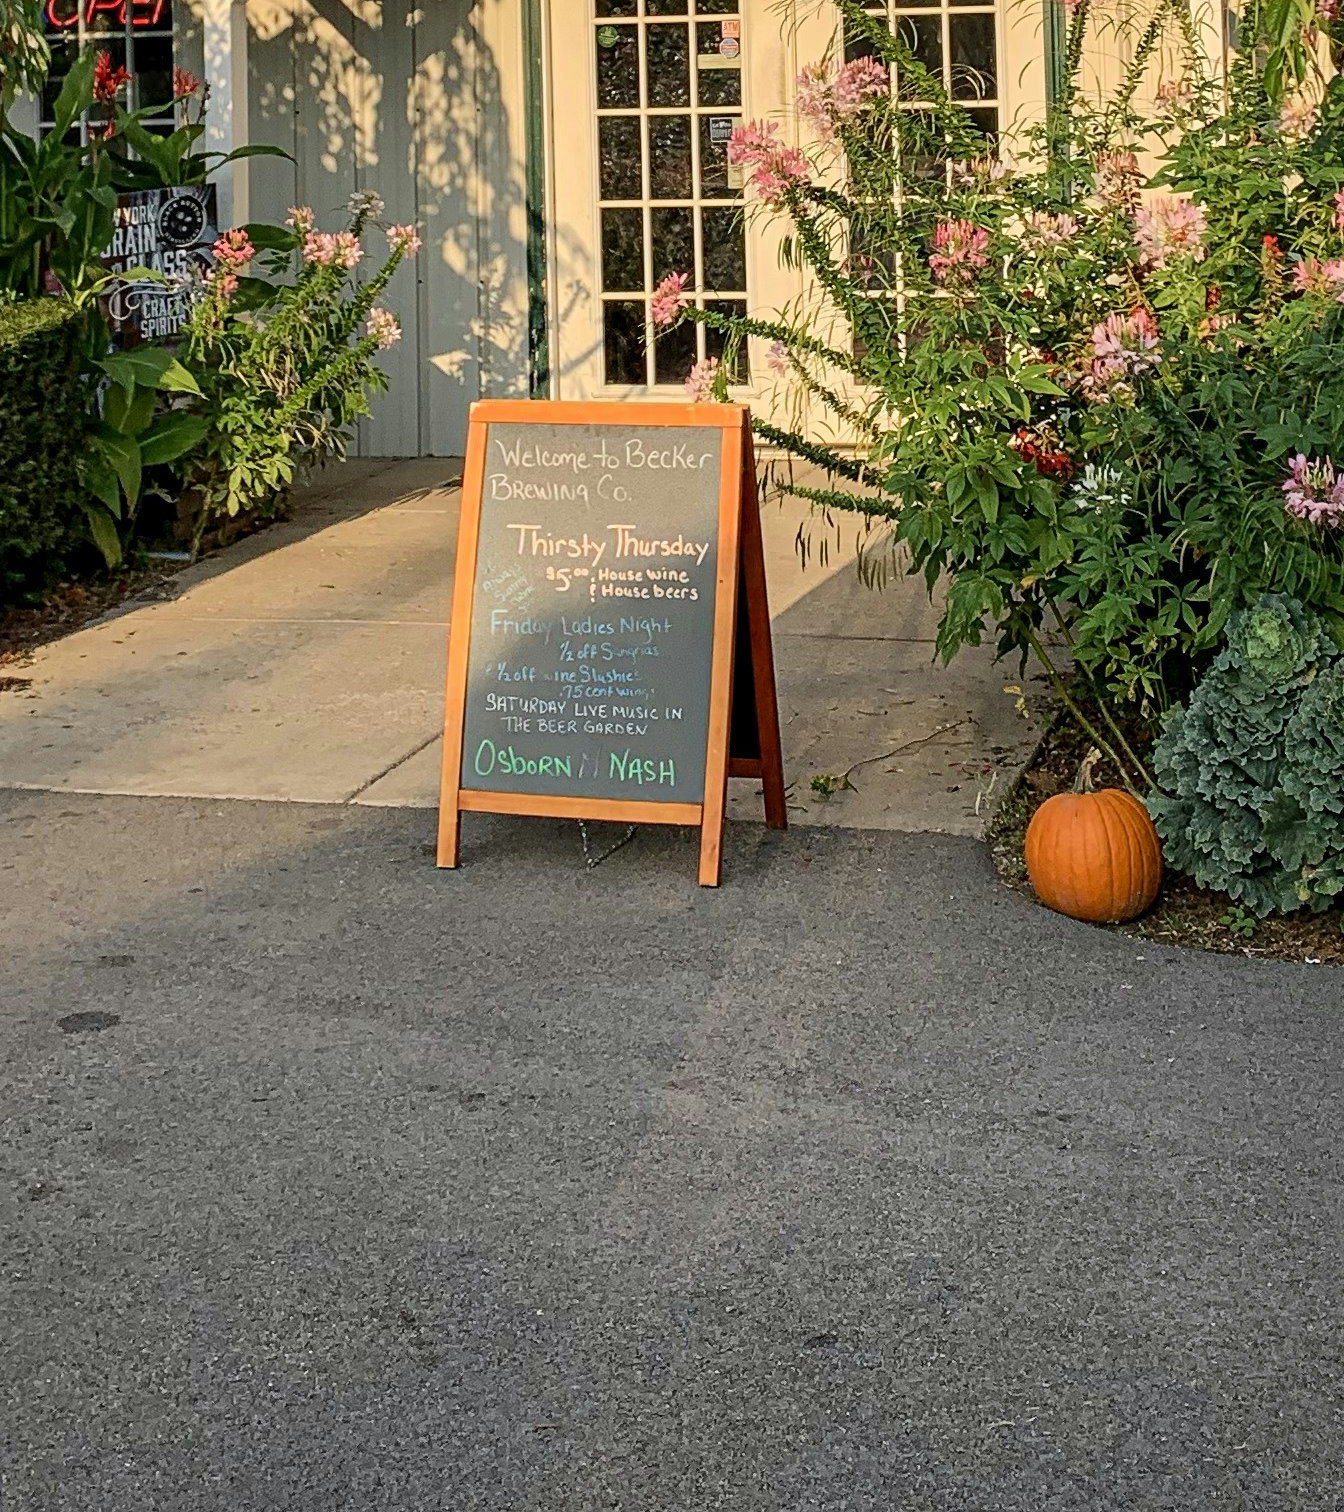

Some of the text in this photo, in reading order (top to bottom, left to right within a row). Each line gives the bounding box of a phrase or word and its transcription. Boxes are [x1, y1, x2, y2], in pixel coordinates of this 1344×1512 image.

[123, 204, 155, 226] YORK
[495, 439, 591, 474] Welcome
[594, 439, 620, 469] to
[597, 474, 632, 502] Co.
[507, 524, 709, 567] Thirsty Thursday
[598, 567, 643, 583] House
[646, 567, 690, 584] wine
[601, 583, 650, 600] House
[653, 584, 699, 601] beers
[490, 609, 673, 645] Friday Ladies Night
[576, 643, 598, 660] off
[514, 665, 536, 683] off
[485, 692, 682, 720] SATURDAY LIVE MUSIC IN
[500, 716, 649, 736] THE BEER GARDEN
[609, 748, 675, 787] NASH
